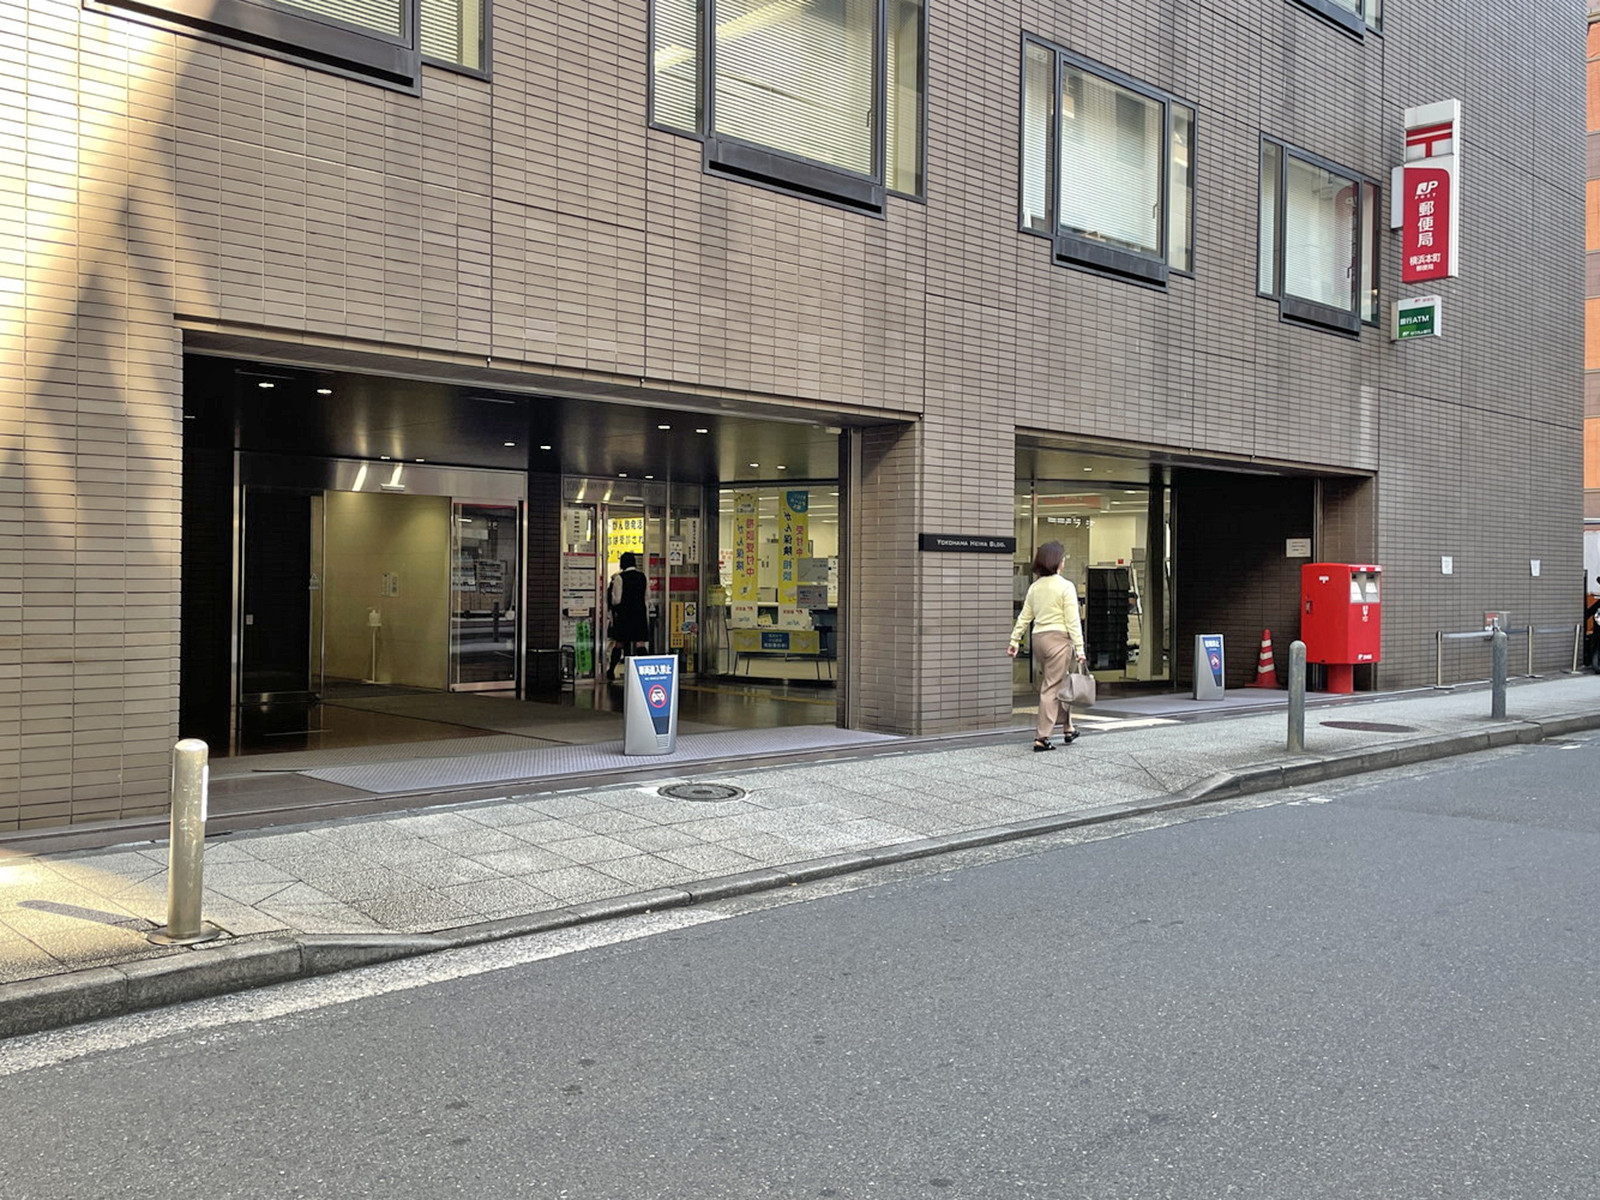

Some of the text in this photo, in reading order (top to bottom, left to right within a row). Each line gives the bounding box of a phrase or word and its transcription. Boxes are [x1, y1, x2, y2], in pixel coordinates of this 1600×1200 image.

[1417, 201, 1434, 248] 郵便局
[1409, 252, 1441, 266] 横浜本町
